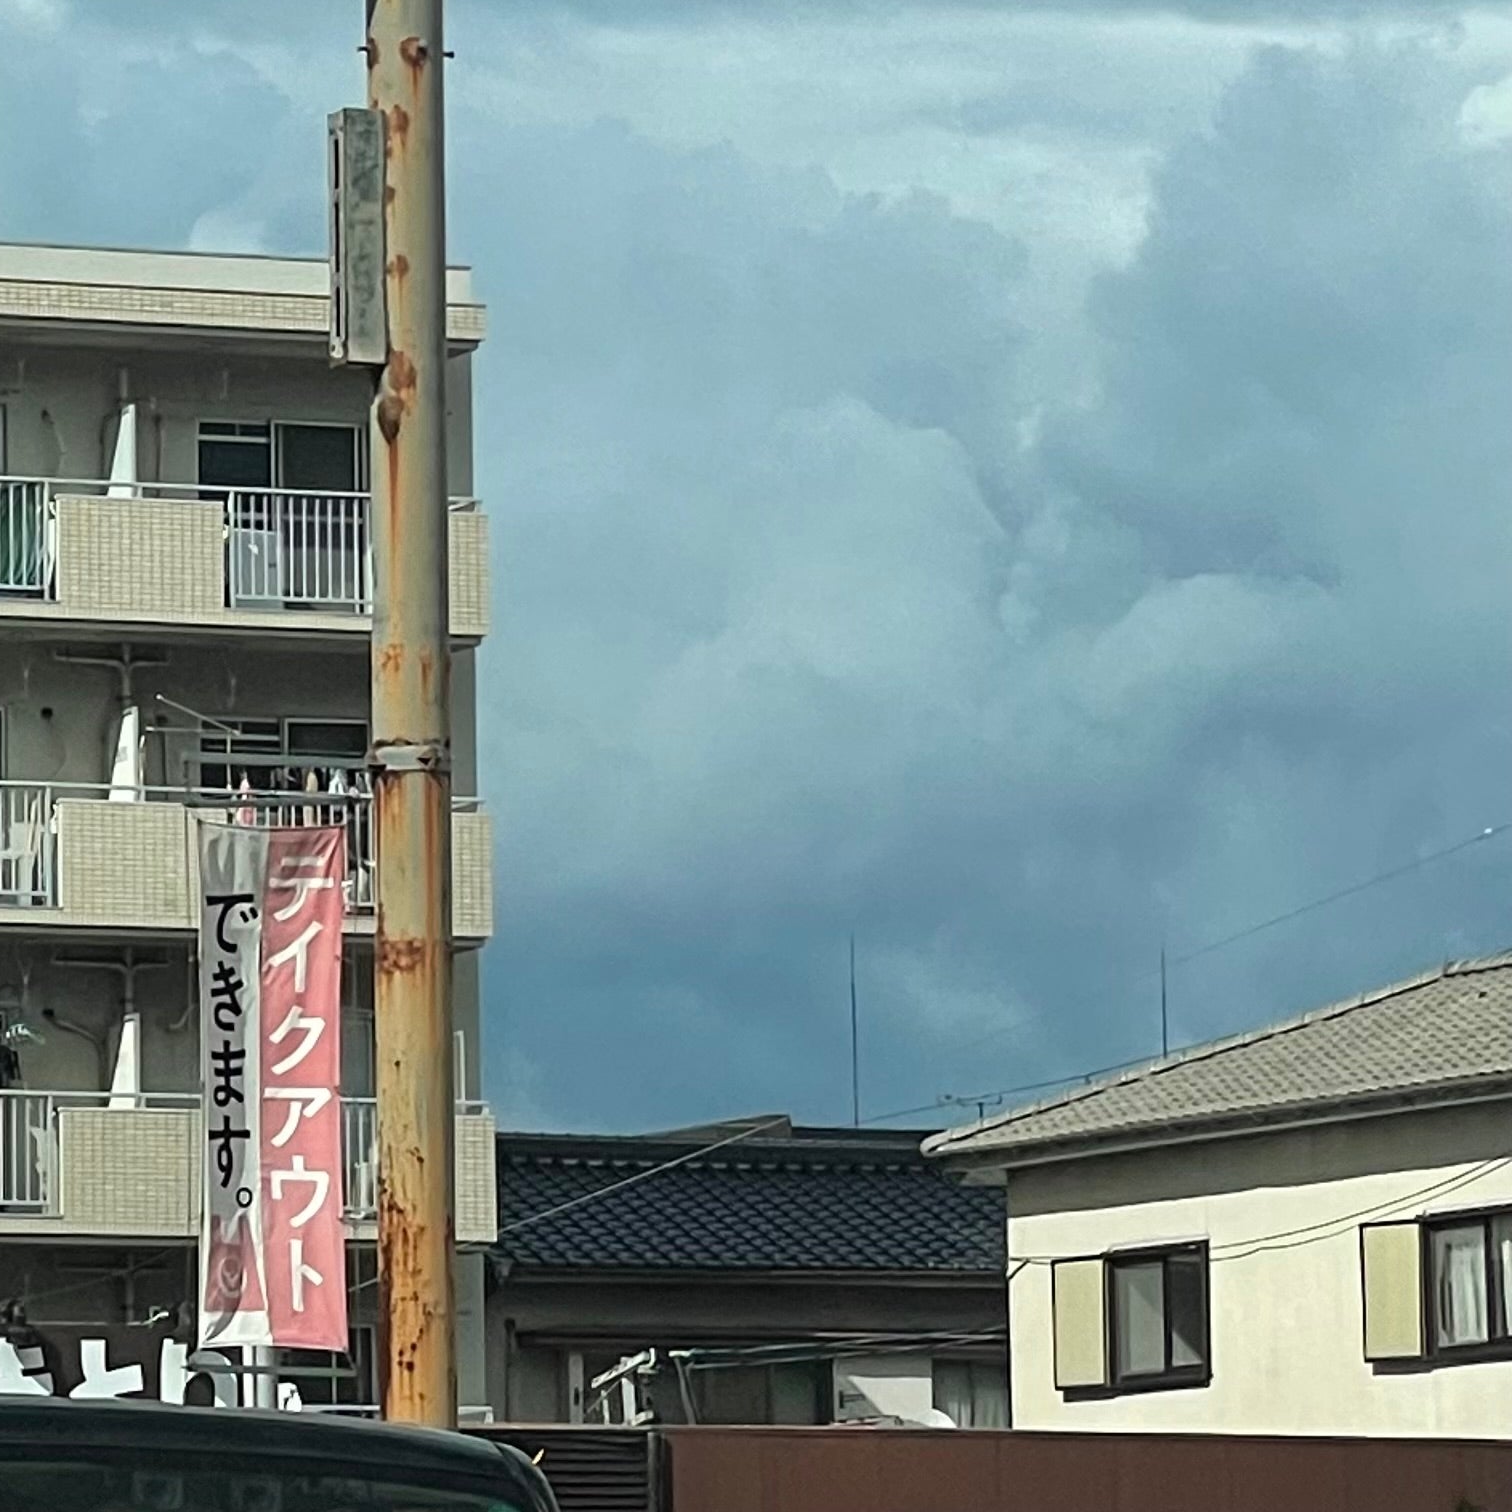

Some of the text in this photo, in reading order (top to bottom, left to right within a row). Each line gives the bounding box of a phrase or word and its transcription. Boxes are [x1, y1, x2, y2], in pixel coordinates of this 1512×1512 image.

[206, 892, 260, 1210] できます。
[261, 856, 335, 1313] テイクアウト
